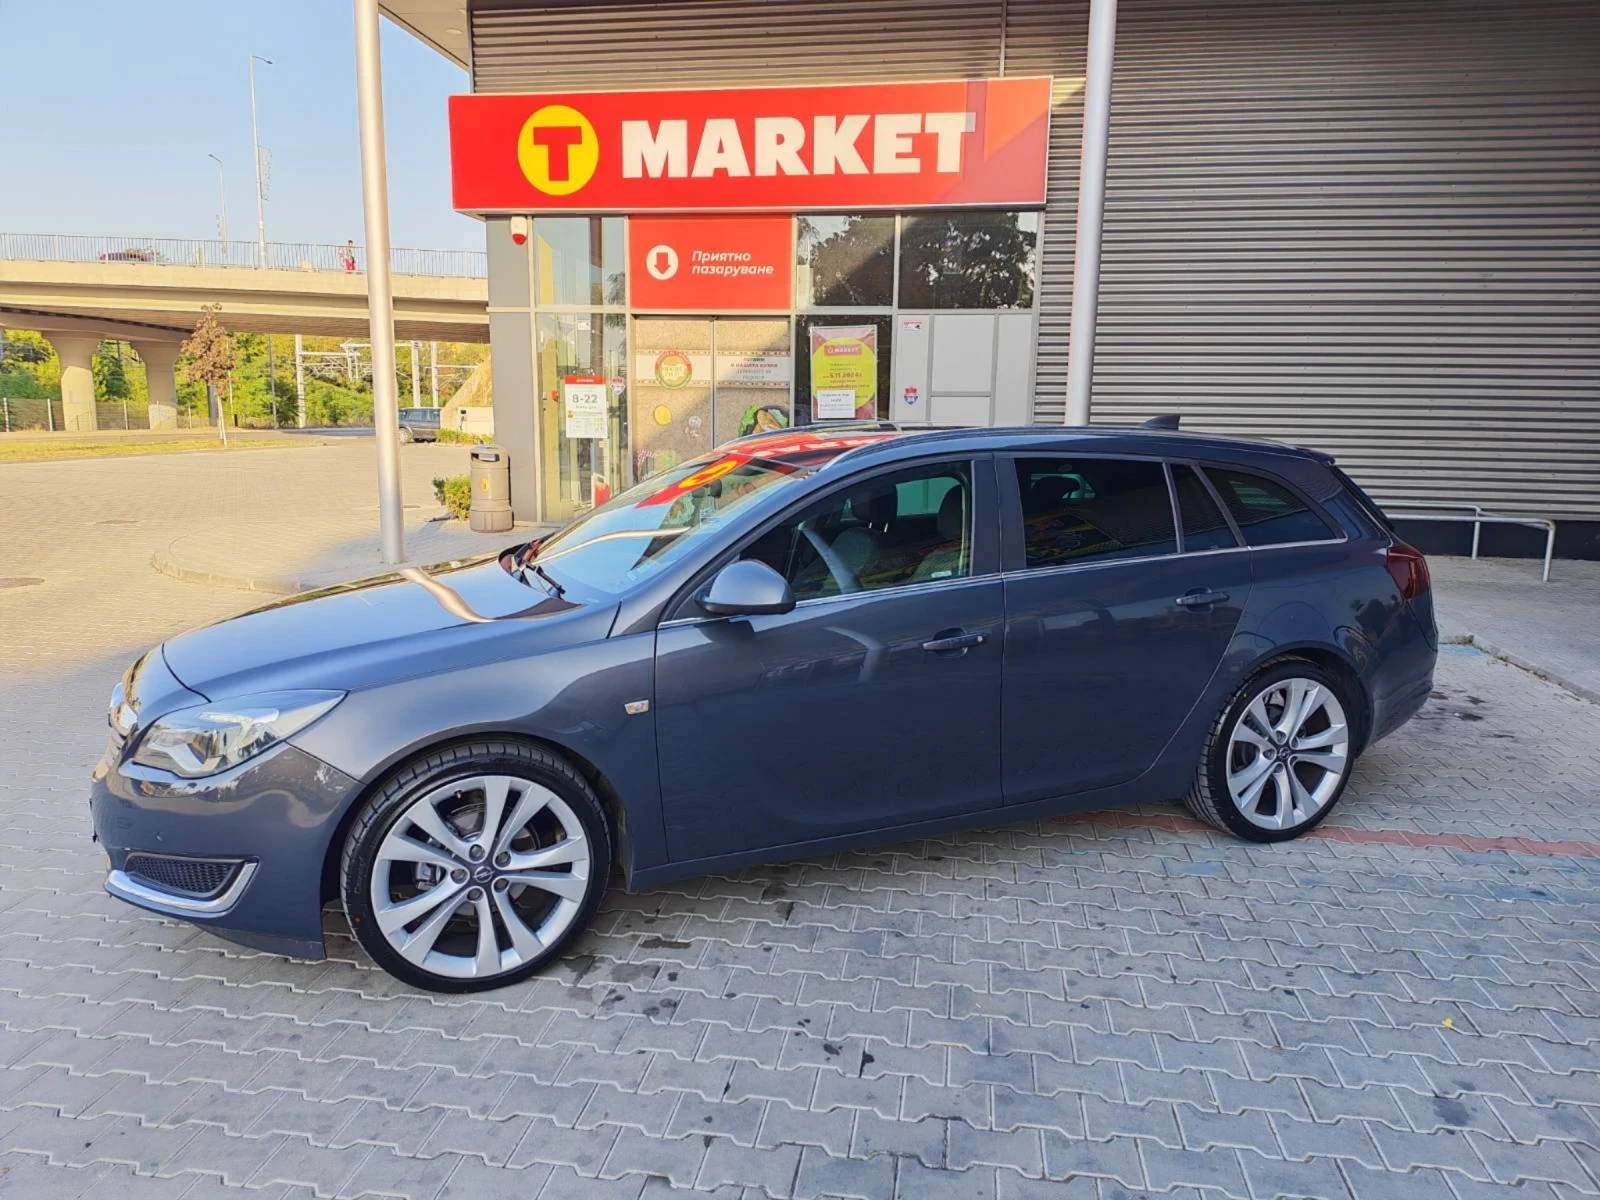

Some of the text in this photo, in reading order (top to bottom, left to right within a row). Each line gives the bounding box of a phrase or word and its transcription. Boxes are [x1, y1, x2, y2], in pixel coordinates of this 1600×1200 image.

[533, 112, 976, 182] T MARKET
[691, 250, 752, 263] Приятно
[691, 264, 775, 277] пазаруване
[572, 393, 599, 404] 8-22
